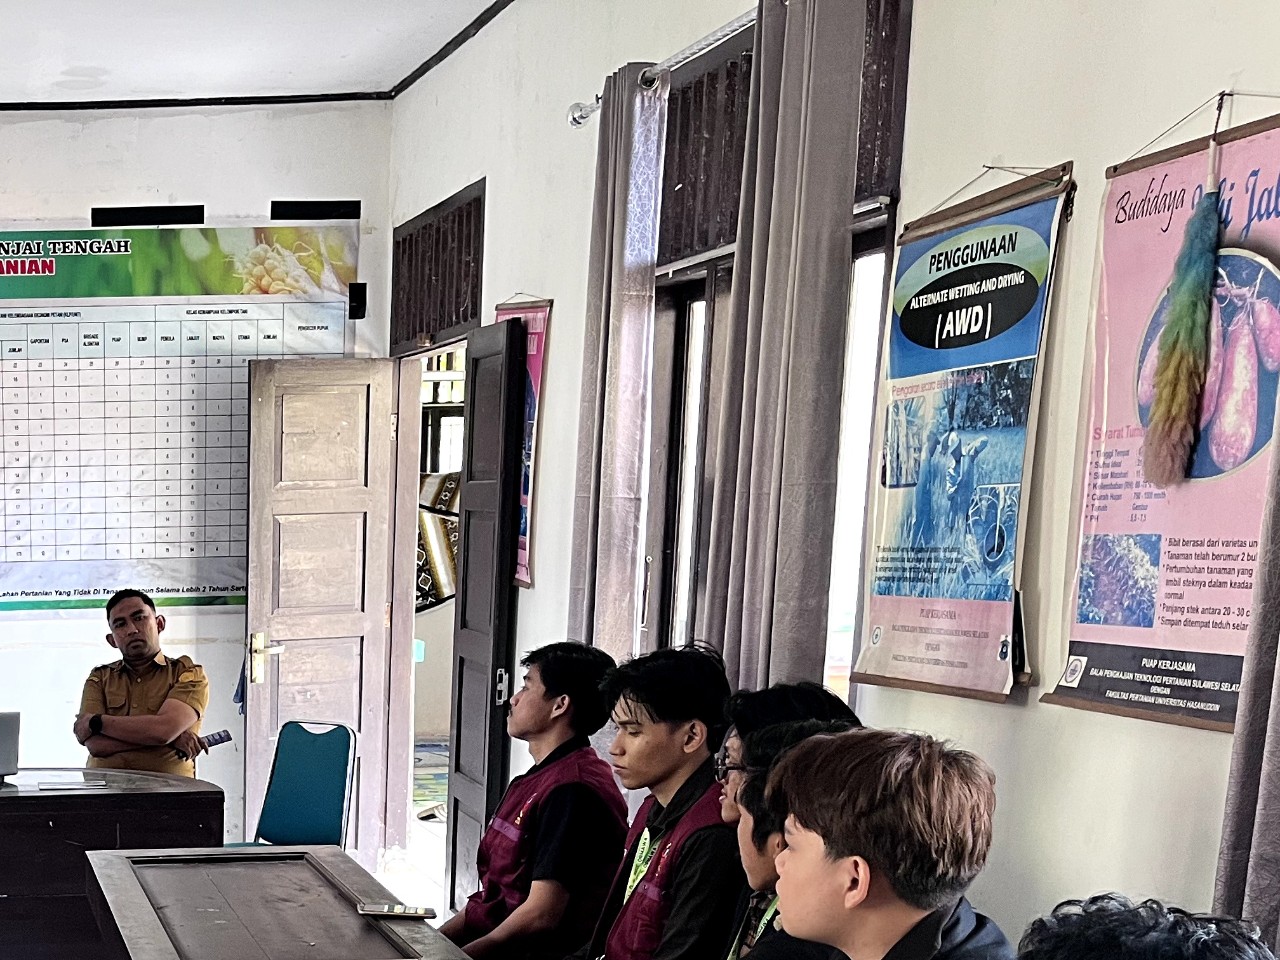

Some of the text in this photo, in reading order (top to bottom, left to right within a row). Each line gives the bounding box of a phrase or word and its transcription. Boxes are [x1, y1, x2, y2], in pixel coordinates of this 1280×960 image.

[1114, 173, 1187, 233] Budidaya
[48, 240, 131, 254] TENGAH
[928, 231, 1018, 275] PENGGUNAAN
[910, 270, 1025, 310] ALTERNATE WETTING AND DRYING
[1182, 538, 1205, 547] berasal
[1206, 538, 1219, 547] dari
[1222, 539, 1247, 548] varietas
[1248, 540, 1258, 548] un
[1167, 551, 1192, 560] Tanaman
[1194, 551, 1210, 560] telah
[1211, 552, 1239, 561] berumur
[1241, 552, 1245, 561] 2
[1207, 565, 1235, 575] tanaman
[1237, 567, 1253, 577] yang
[1182, 579, 1206, 589] steknya
[1208, 579, 1227, 588] dalam
[54, 589, 71, 597] Yang
[1162, 603, 1185, 615] Panjang
[1186, 605, 1199, 614] stek
[1200, 607, 1221, 615] antara
[1222, 607, 1231, 615] 20
[1236, 608, 1245, 617] 30
[1183, 618, 1210, 629] ditempat
[1211, 619, 1230, 630] teduh
[1158, 660, 1196, 673] KERJASAMA
